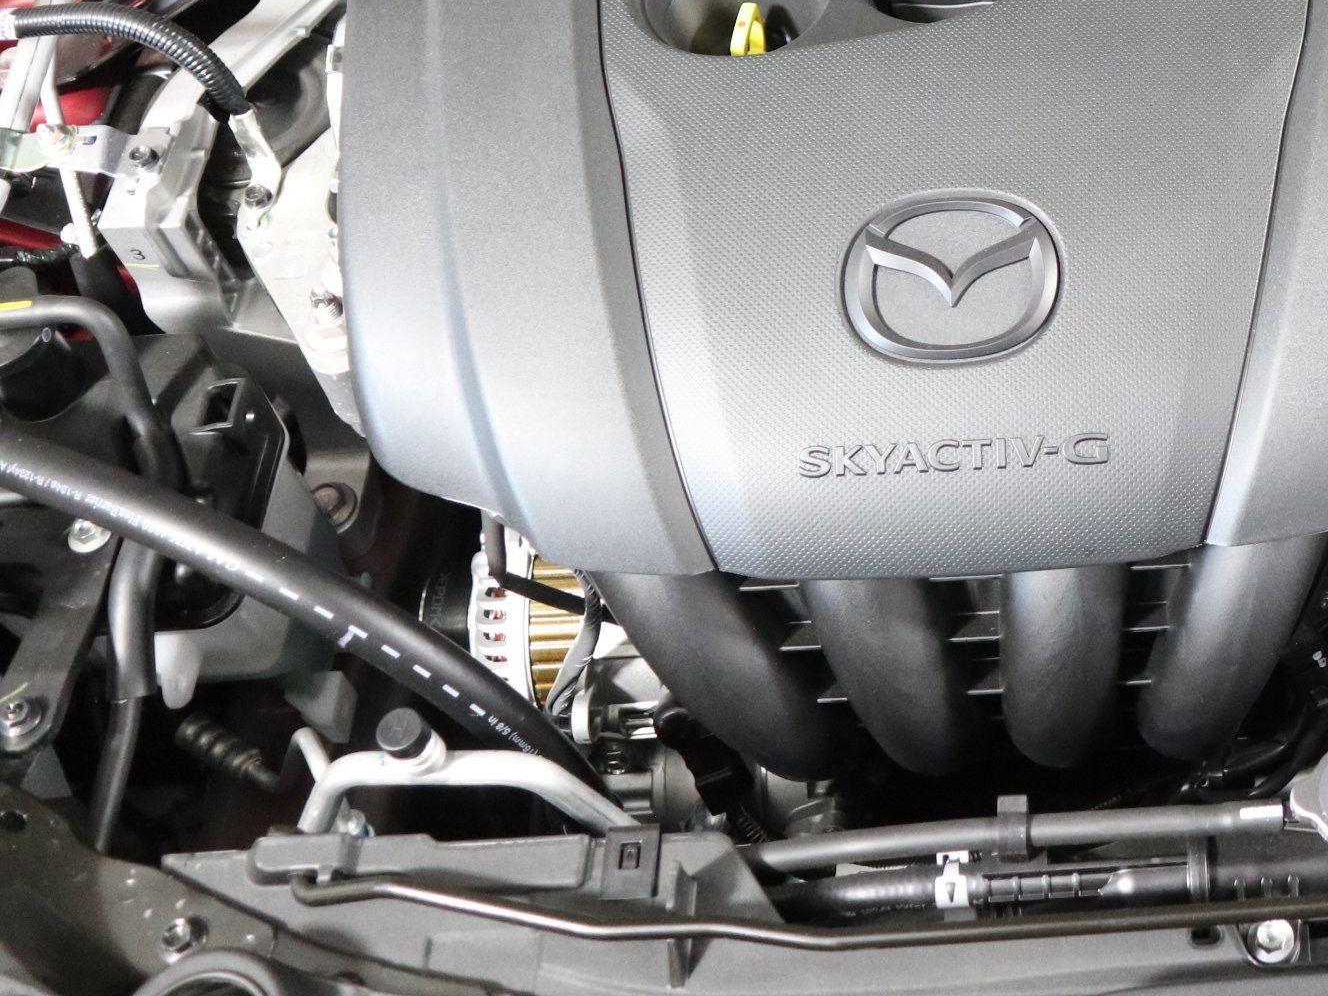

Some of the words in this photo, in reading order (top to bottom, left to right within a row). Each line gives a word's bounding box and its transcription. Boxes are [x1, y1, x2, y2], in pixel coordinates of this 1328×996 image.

[130, 249, 146, 261] 3
[799, 433, 1110, 478] SKYACTIV-G
[84, 494, 140, 527] FlexBarrier
